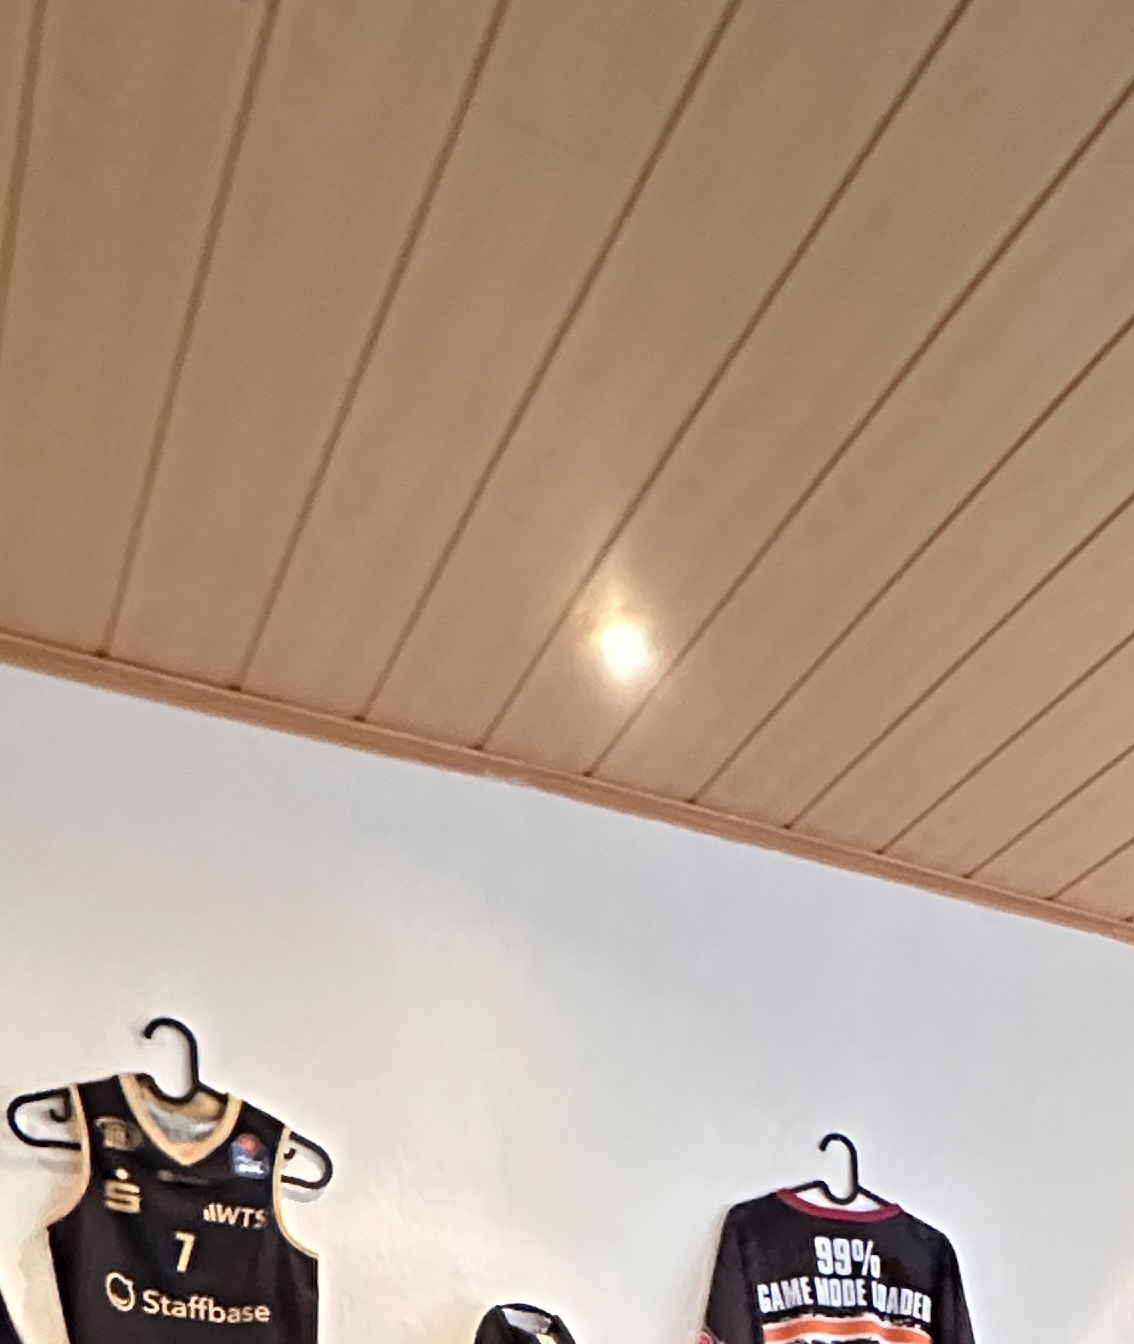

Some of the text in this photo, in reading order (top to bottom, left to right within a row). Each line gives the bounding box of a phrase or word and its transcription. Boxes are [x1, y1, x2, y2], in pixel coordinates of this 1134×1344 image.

[173, 1230, 195, 1272] 7
[813, 1235, 882, 1279] 99%
[142, 1289, 271, 1323] Staffbase
[757, 1277, 815, 1314] GAME
